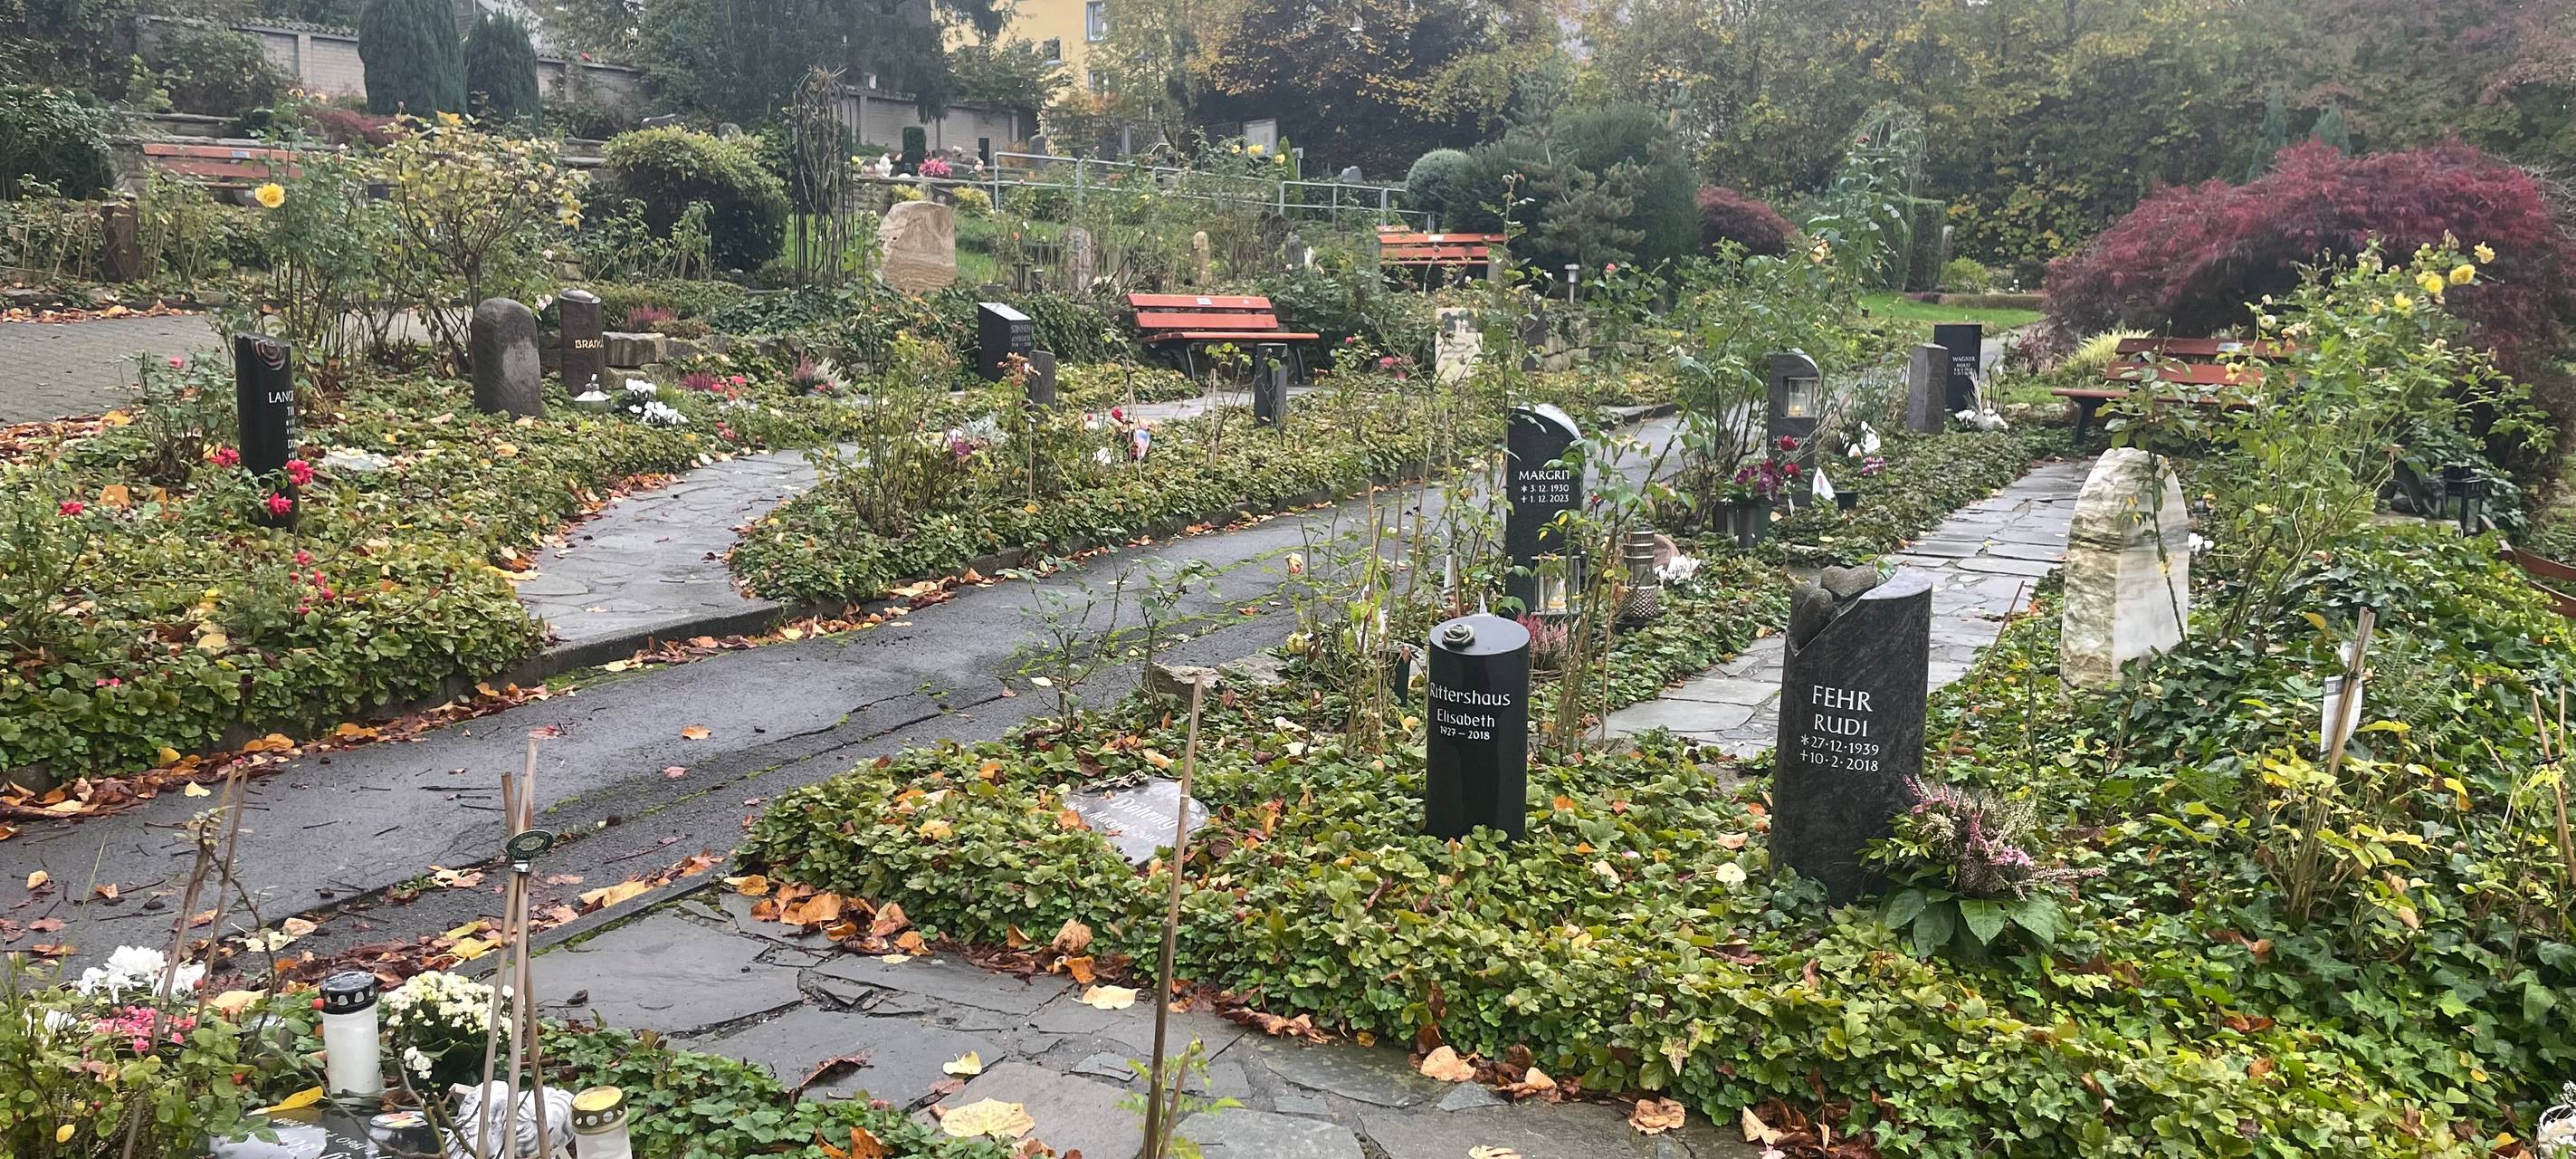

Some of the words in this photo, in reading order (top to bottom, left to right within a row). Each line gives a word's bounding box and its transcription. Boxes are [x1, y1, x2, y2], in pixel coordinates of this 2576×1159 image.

[1518, 470, 1570, 481] MARGRIT
[1429, 682, 1511, 706] Rittershaus
[1812, 685, 1873, 712] FEHR
[1437, 708, 1495, 728] Elisabeth
[1814, 714, 1867, 737] RUDI
[1440, 725, 1456, 736] 1927
[1467, 730, 1491, 741] 2018
[1110, 798, 1179, 830] Döhring
